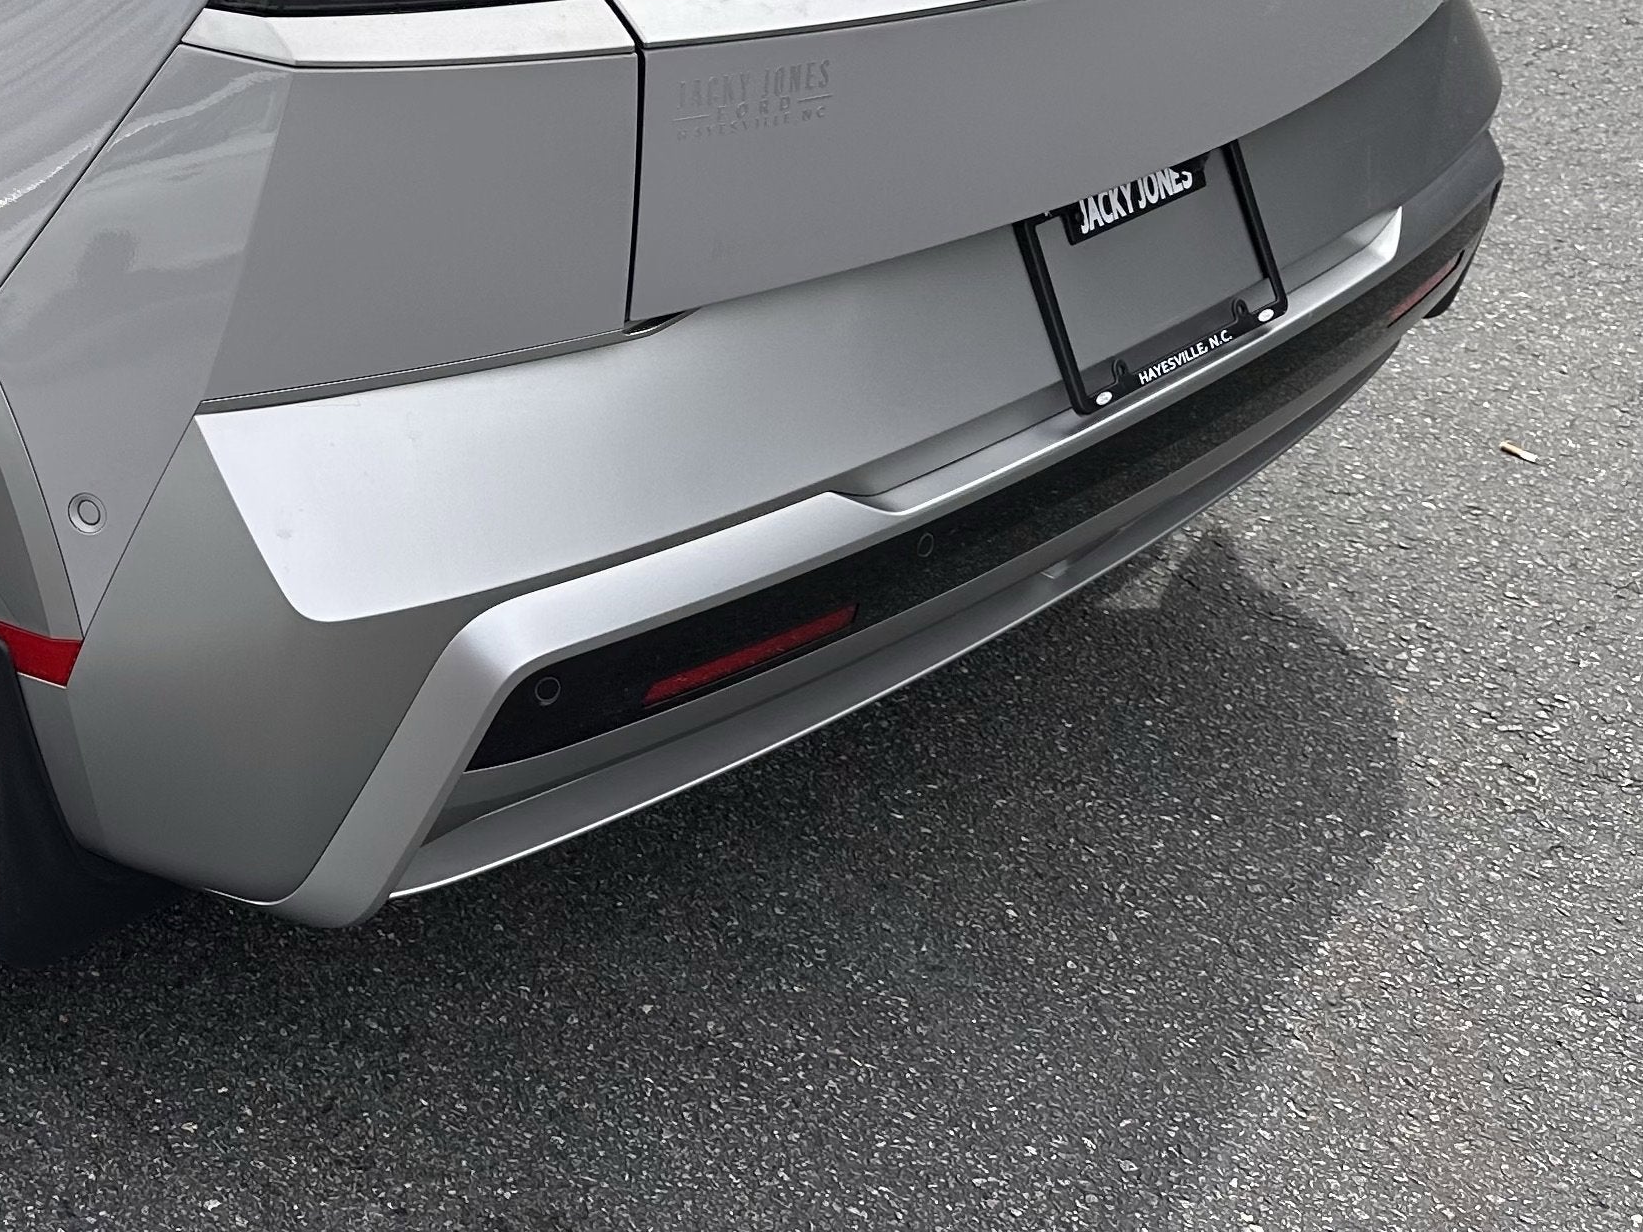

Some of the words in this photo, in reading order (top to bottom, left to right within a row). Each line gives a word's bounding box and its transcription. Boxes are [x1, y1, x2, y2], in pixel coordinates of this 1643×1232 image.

[1079, 183, 1134, 234] JACKY
[1138, 168, 1193, 209] JONES
[1138, 342, 1209, 385] HAYESVILLE,
[1208, 330, 1233, 349] N.C.
